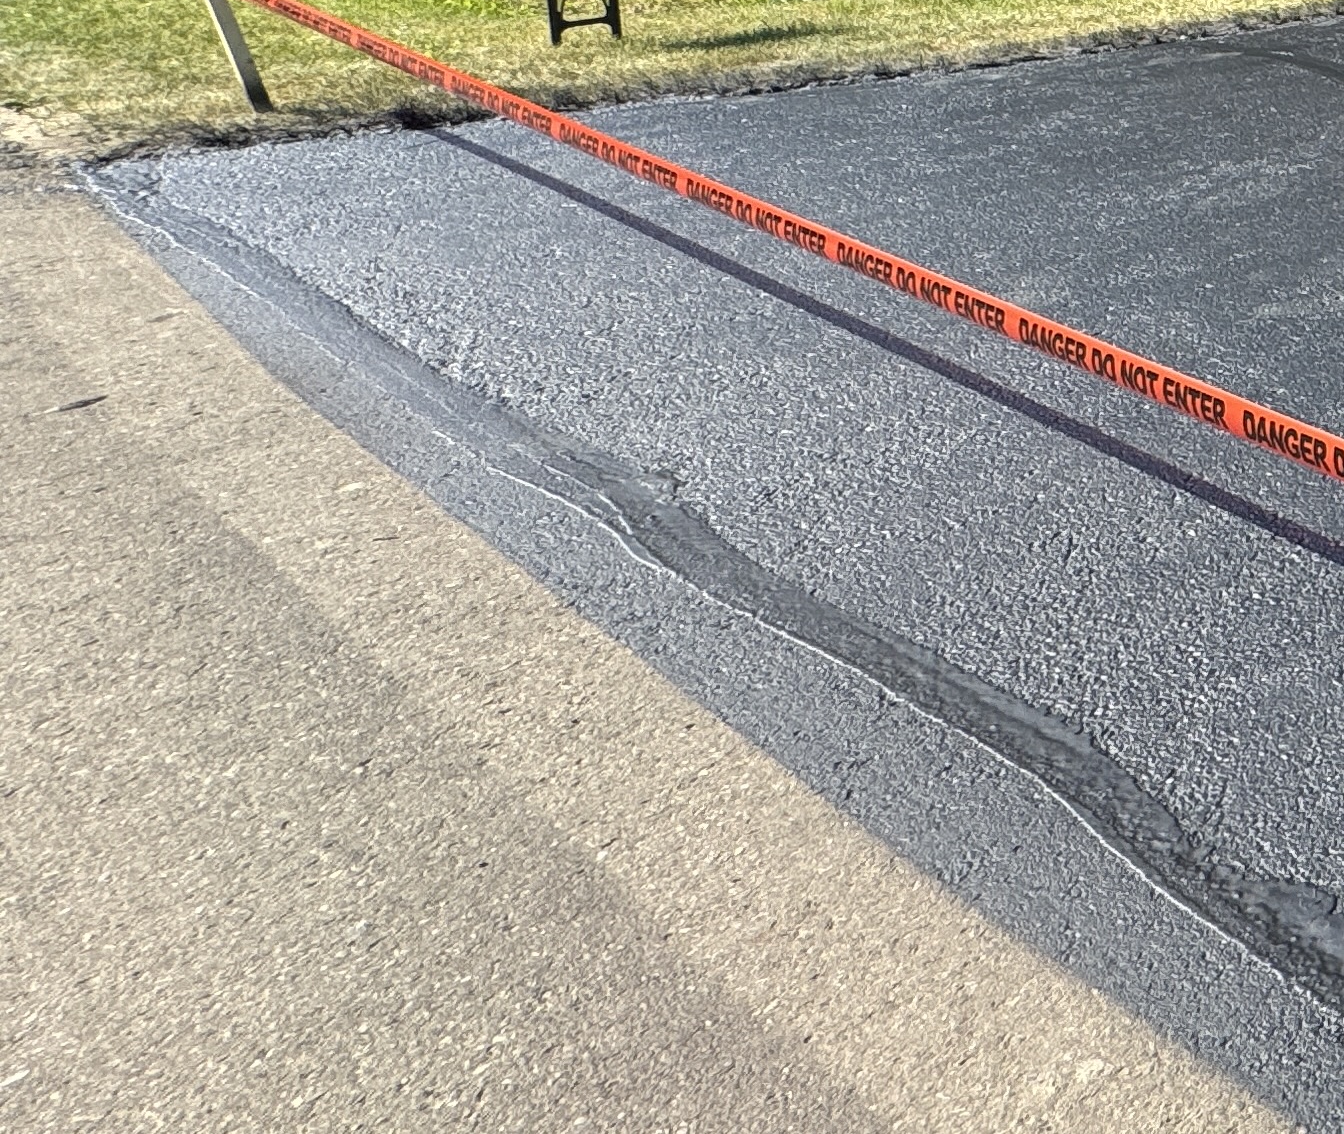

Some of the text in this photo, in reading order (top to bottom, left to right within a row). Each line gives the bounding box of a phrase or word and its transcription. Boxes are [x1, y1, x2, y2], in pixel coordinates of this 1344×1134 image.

[560, 123, 678, 187] DANGER DO NOT ENTER
[686, 178, 827, 257] DANGER DO NOT ENTER
[837, 241, 1008, 336] DANGER DO NOT ENTER
[1019, 318, 1230, 430] DANGER DO NOT ENTER
[1243, 410, 1331, 473] DANGER
